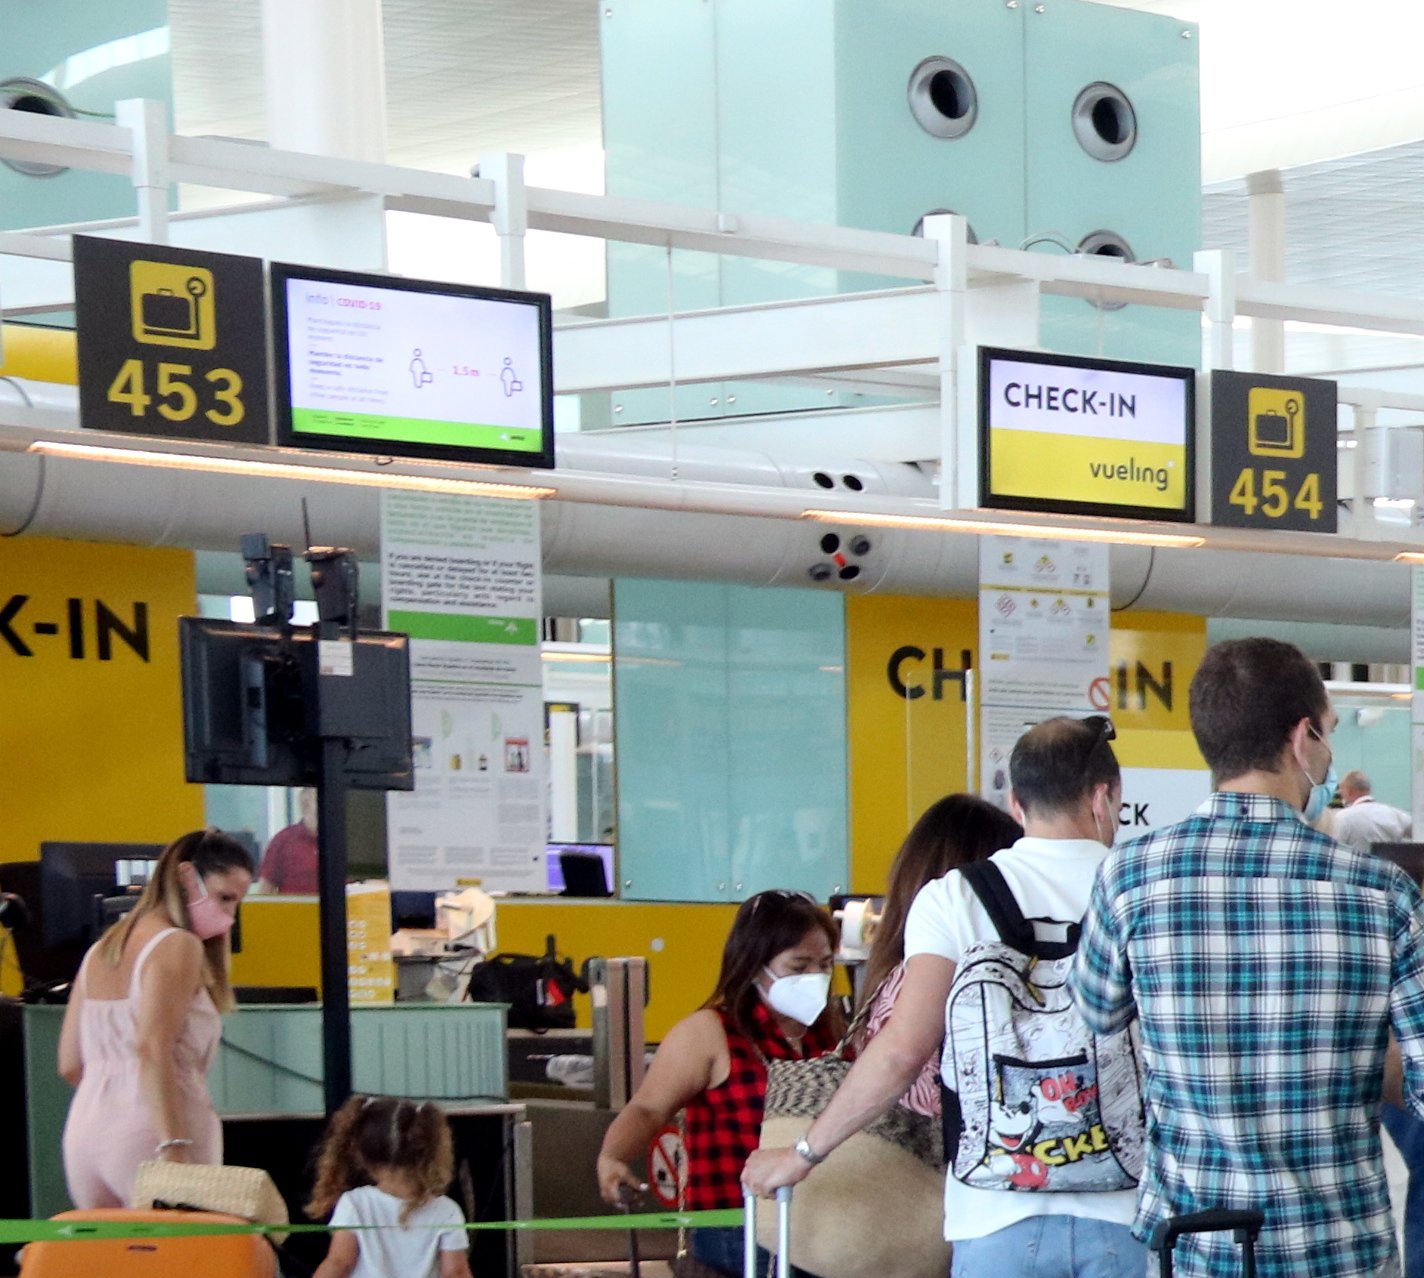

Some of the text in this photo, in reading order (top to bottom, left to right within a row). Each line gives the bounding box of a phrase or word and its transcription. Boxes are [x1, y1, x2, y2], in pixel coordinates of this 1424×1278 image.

[108, 357, 245, 427] 453
[1003, 381, 1138, 420] CHECK-IN
[1088, 457, 1170, 493] vueling
[1228, 467, 1324, 521] 454
[1040, 1071, 1078, 1102] OH
